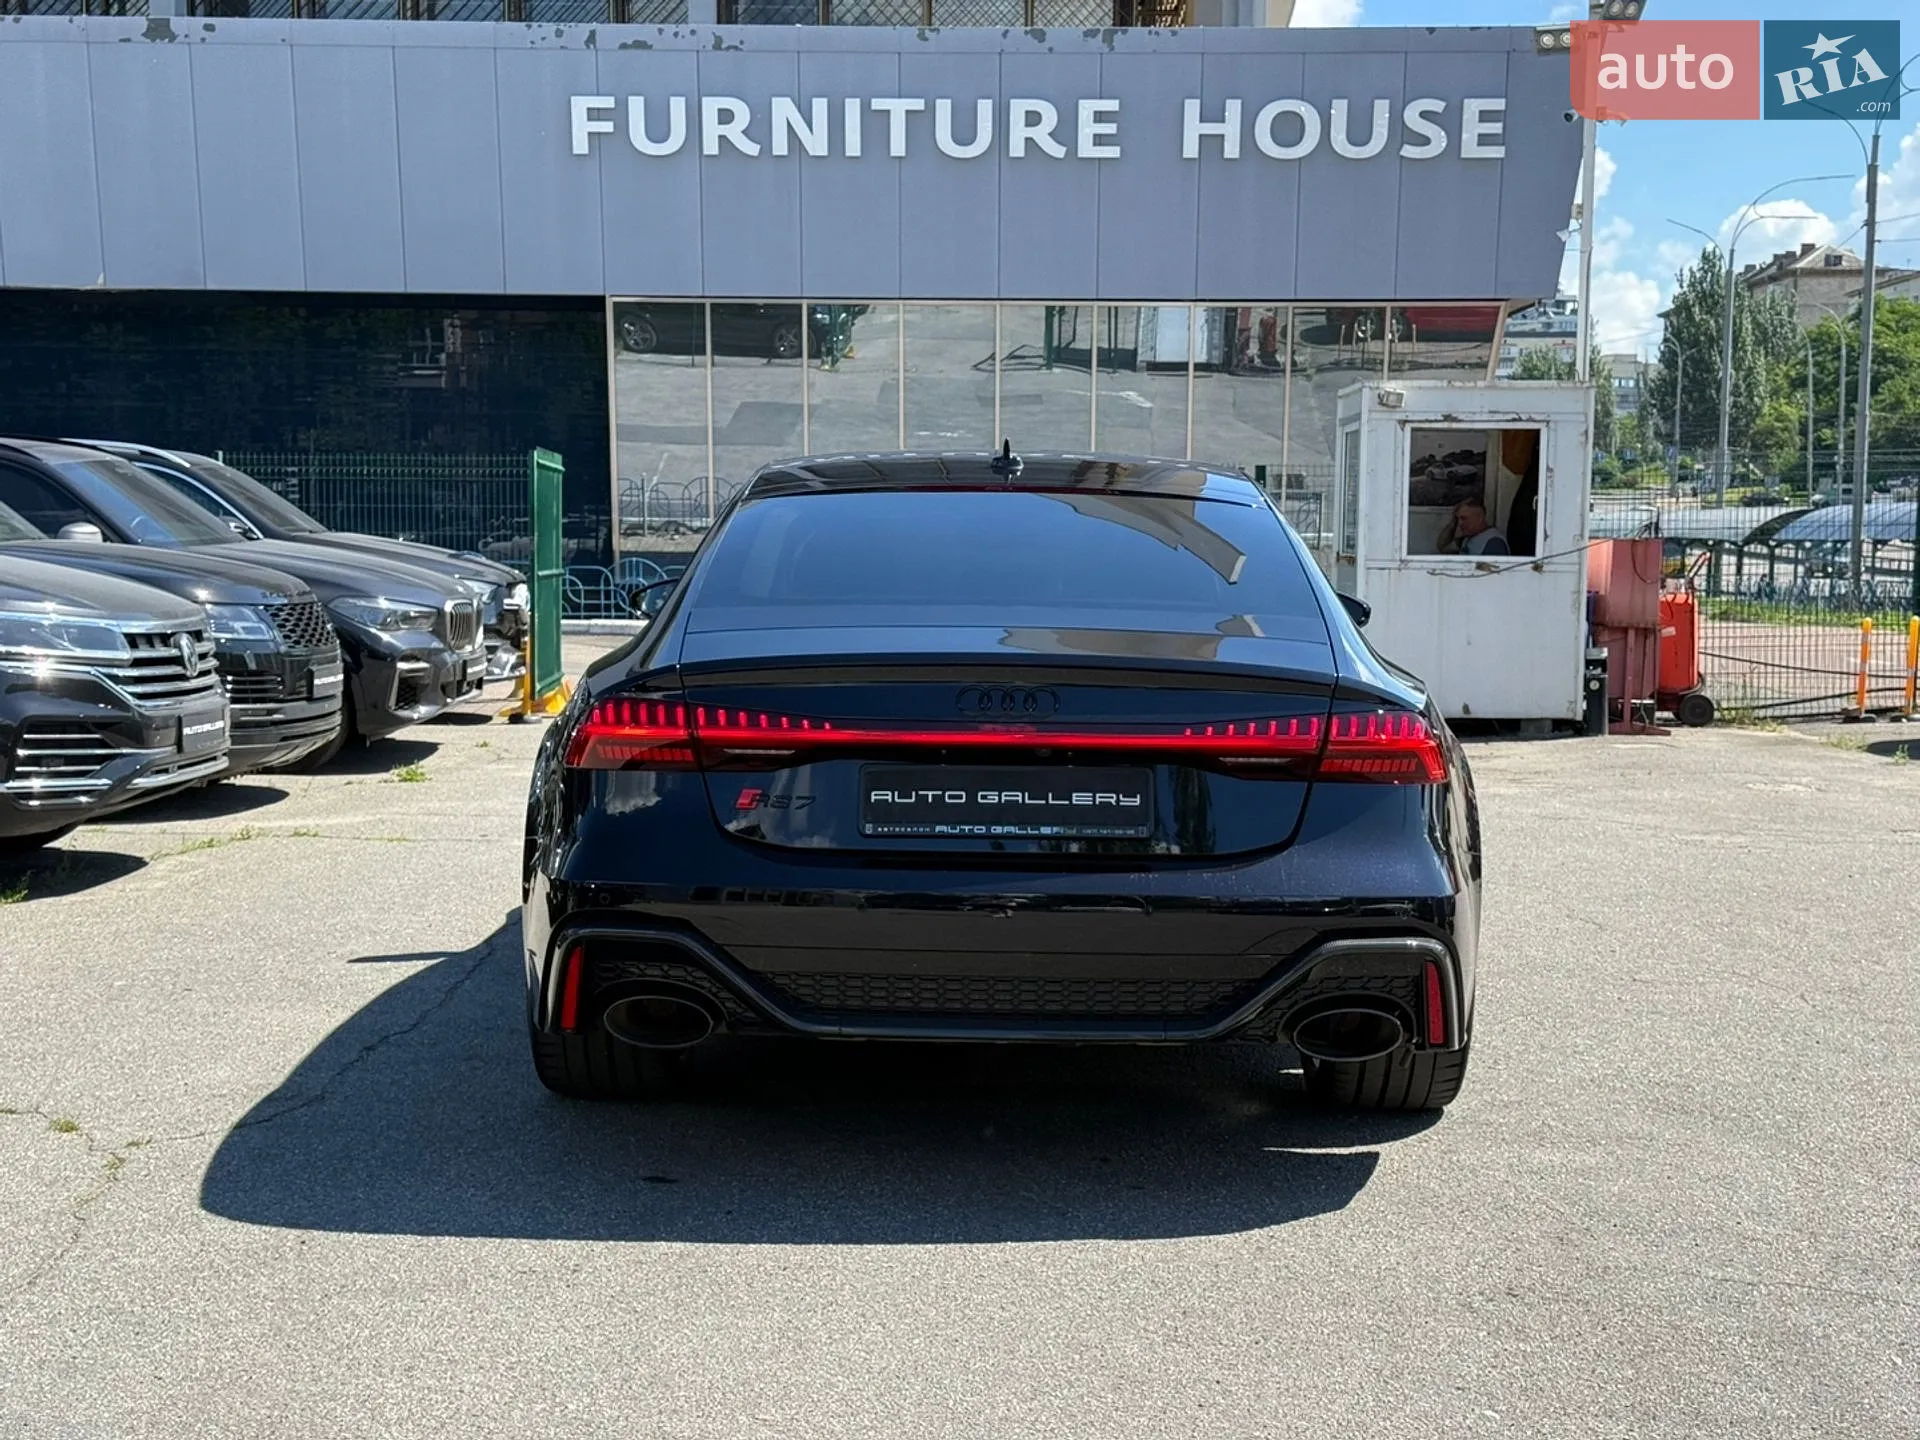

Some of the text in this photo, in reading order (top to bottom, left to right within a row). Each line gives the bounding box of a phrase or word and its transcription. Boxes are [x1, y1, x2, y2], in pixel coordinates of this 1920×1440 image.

[569, 94, 1508, 161] FURNITURE HOUSE
[736, 787, 817, 811] RS7
[869, 789, 1142, 807] AUTO GALLERY
[934, 824, 987, 834] AUTO
